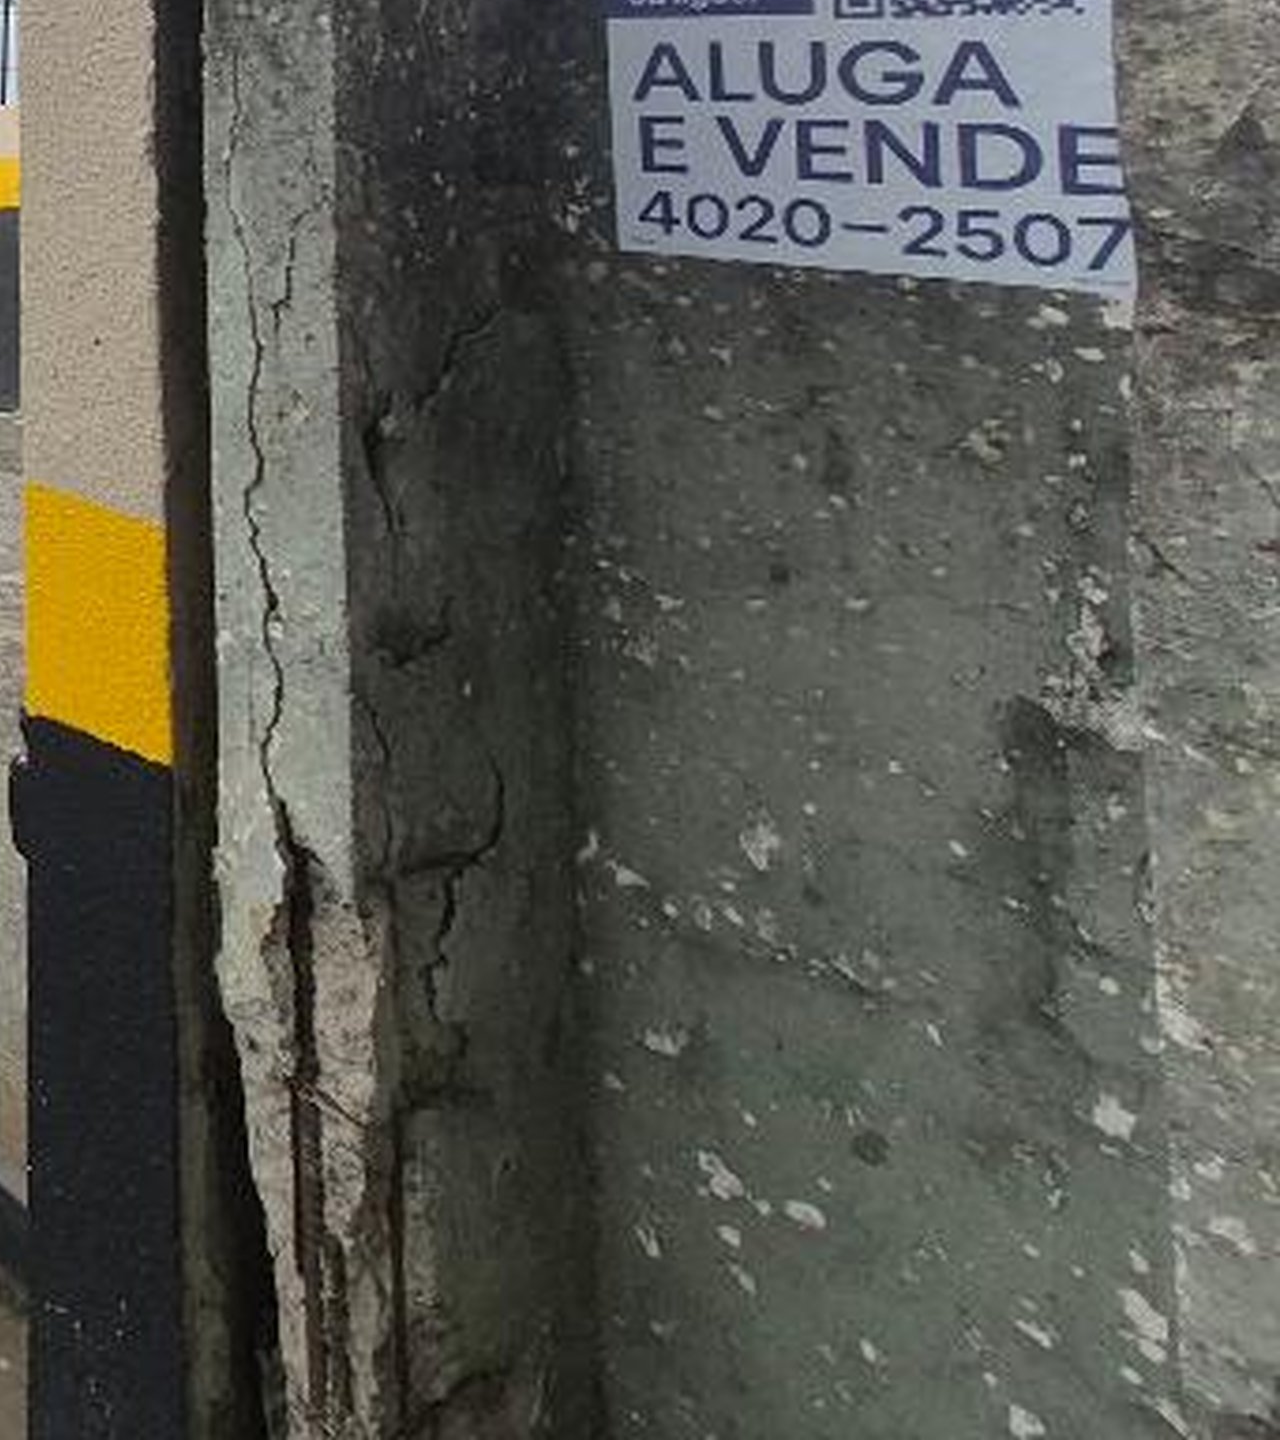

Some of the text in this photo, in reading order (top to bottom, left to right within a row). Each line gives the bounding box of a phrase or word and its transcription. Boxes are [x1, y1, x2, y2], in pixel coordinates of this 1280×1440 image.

[633, 40, 1021, 107] ALUGA
[639, 116, 1126, 196] E VENDE
[638, 191, 1132, 271] 4020-2507
